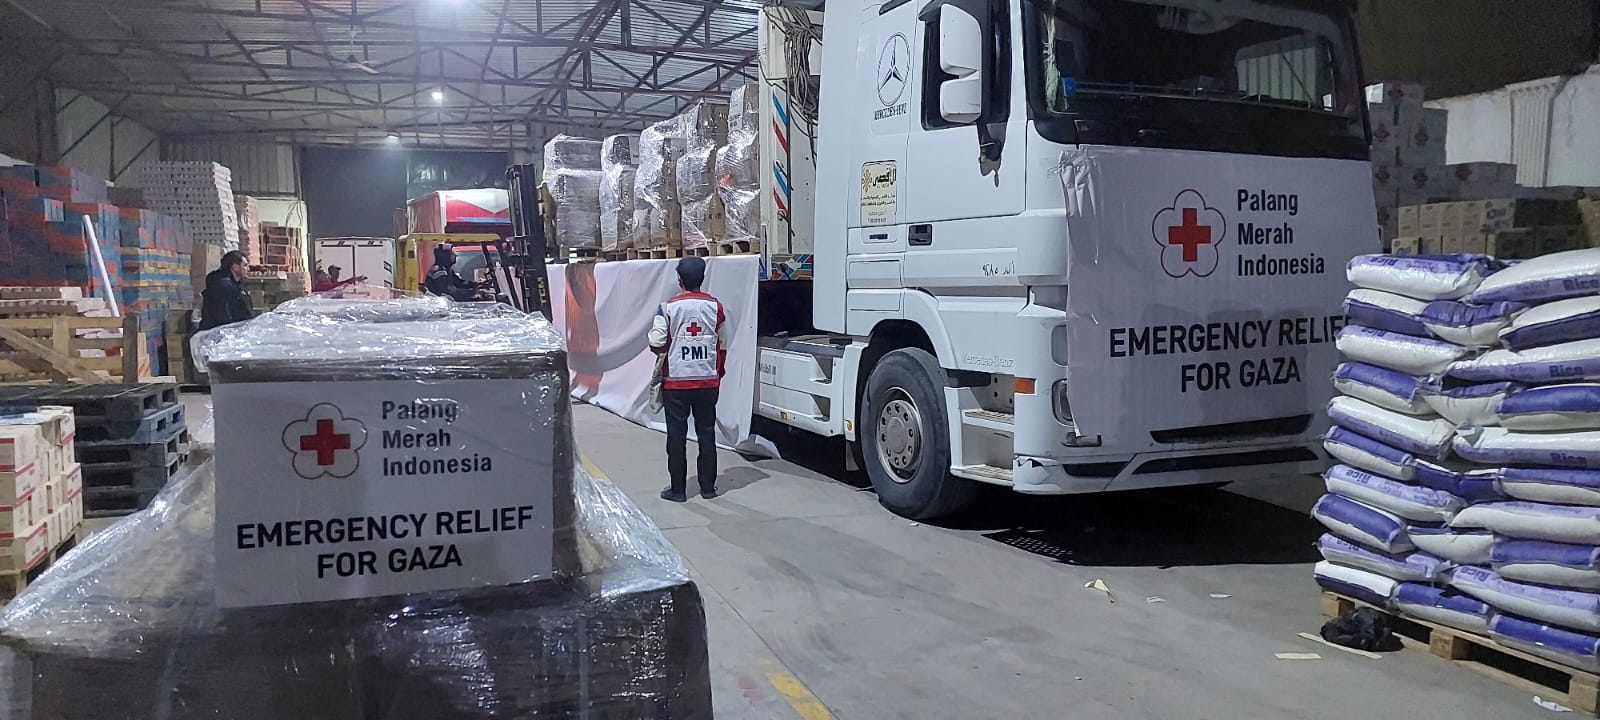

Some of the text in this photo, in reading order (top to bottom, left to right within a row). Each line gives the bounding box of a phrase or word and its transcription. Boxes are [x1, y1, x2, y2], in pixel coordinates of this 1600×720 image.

[1237, 189, 1298, 216] Palang
[1237, 222, 1293, 245] Merah
[1237, 253, 1325, 276] Indonesia
[1109, 319, 1273, 358] EMERGENCY
[681, 345, 708, 360] PMI
[1181, 356, 1301, 393] FOR GAZA
[1549, 365, 1584, 378] Rice
[382, 400, 458, 422] Palang
[383, 429, 451, 449] Merah
[383, 454, 492, 476] Indonesia
[1345, 470, 1372, 484] Rice
[237, 506, 534, 549] EMERGENCY RELIEF
[317, 544, 463, 579] FOR GAZA
[1460, 567, 1490, 583] Rice
